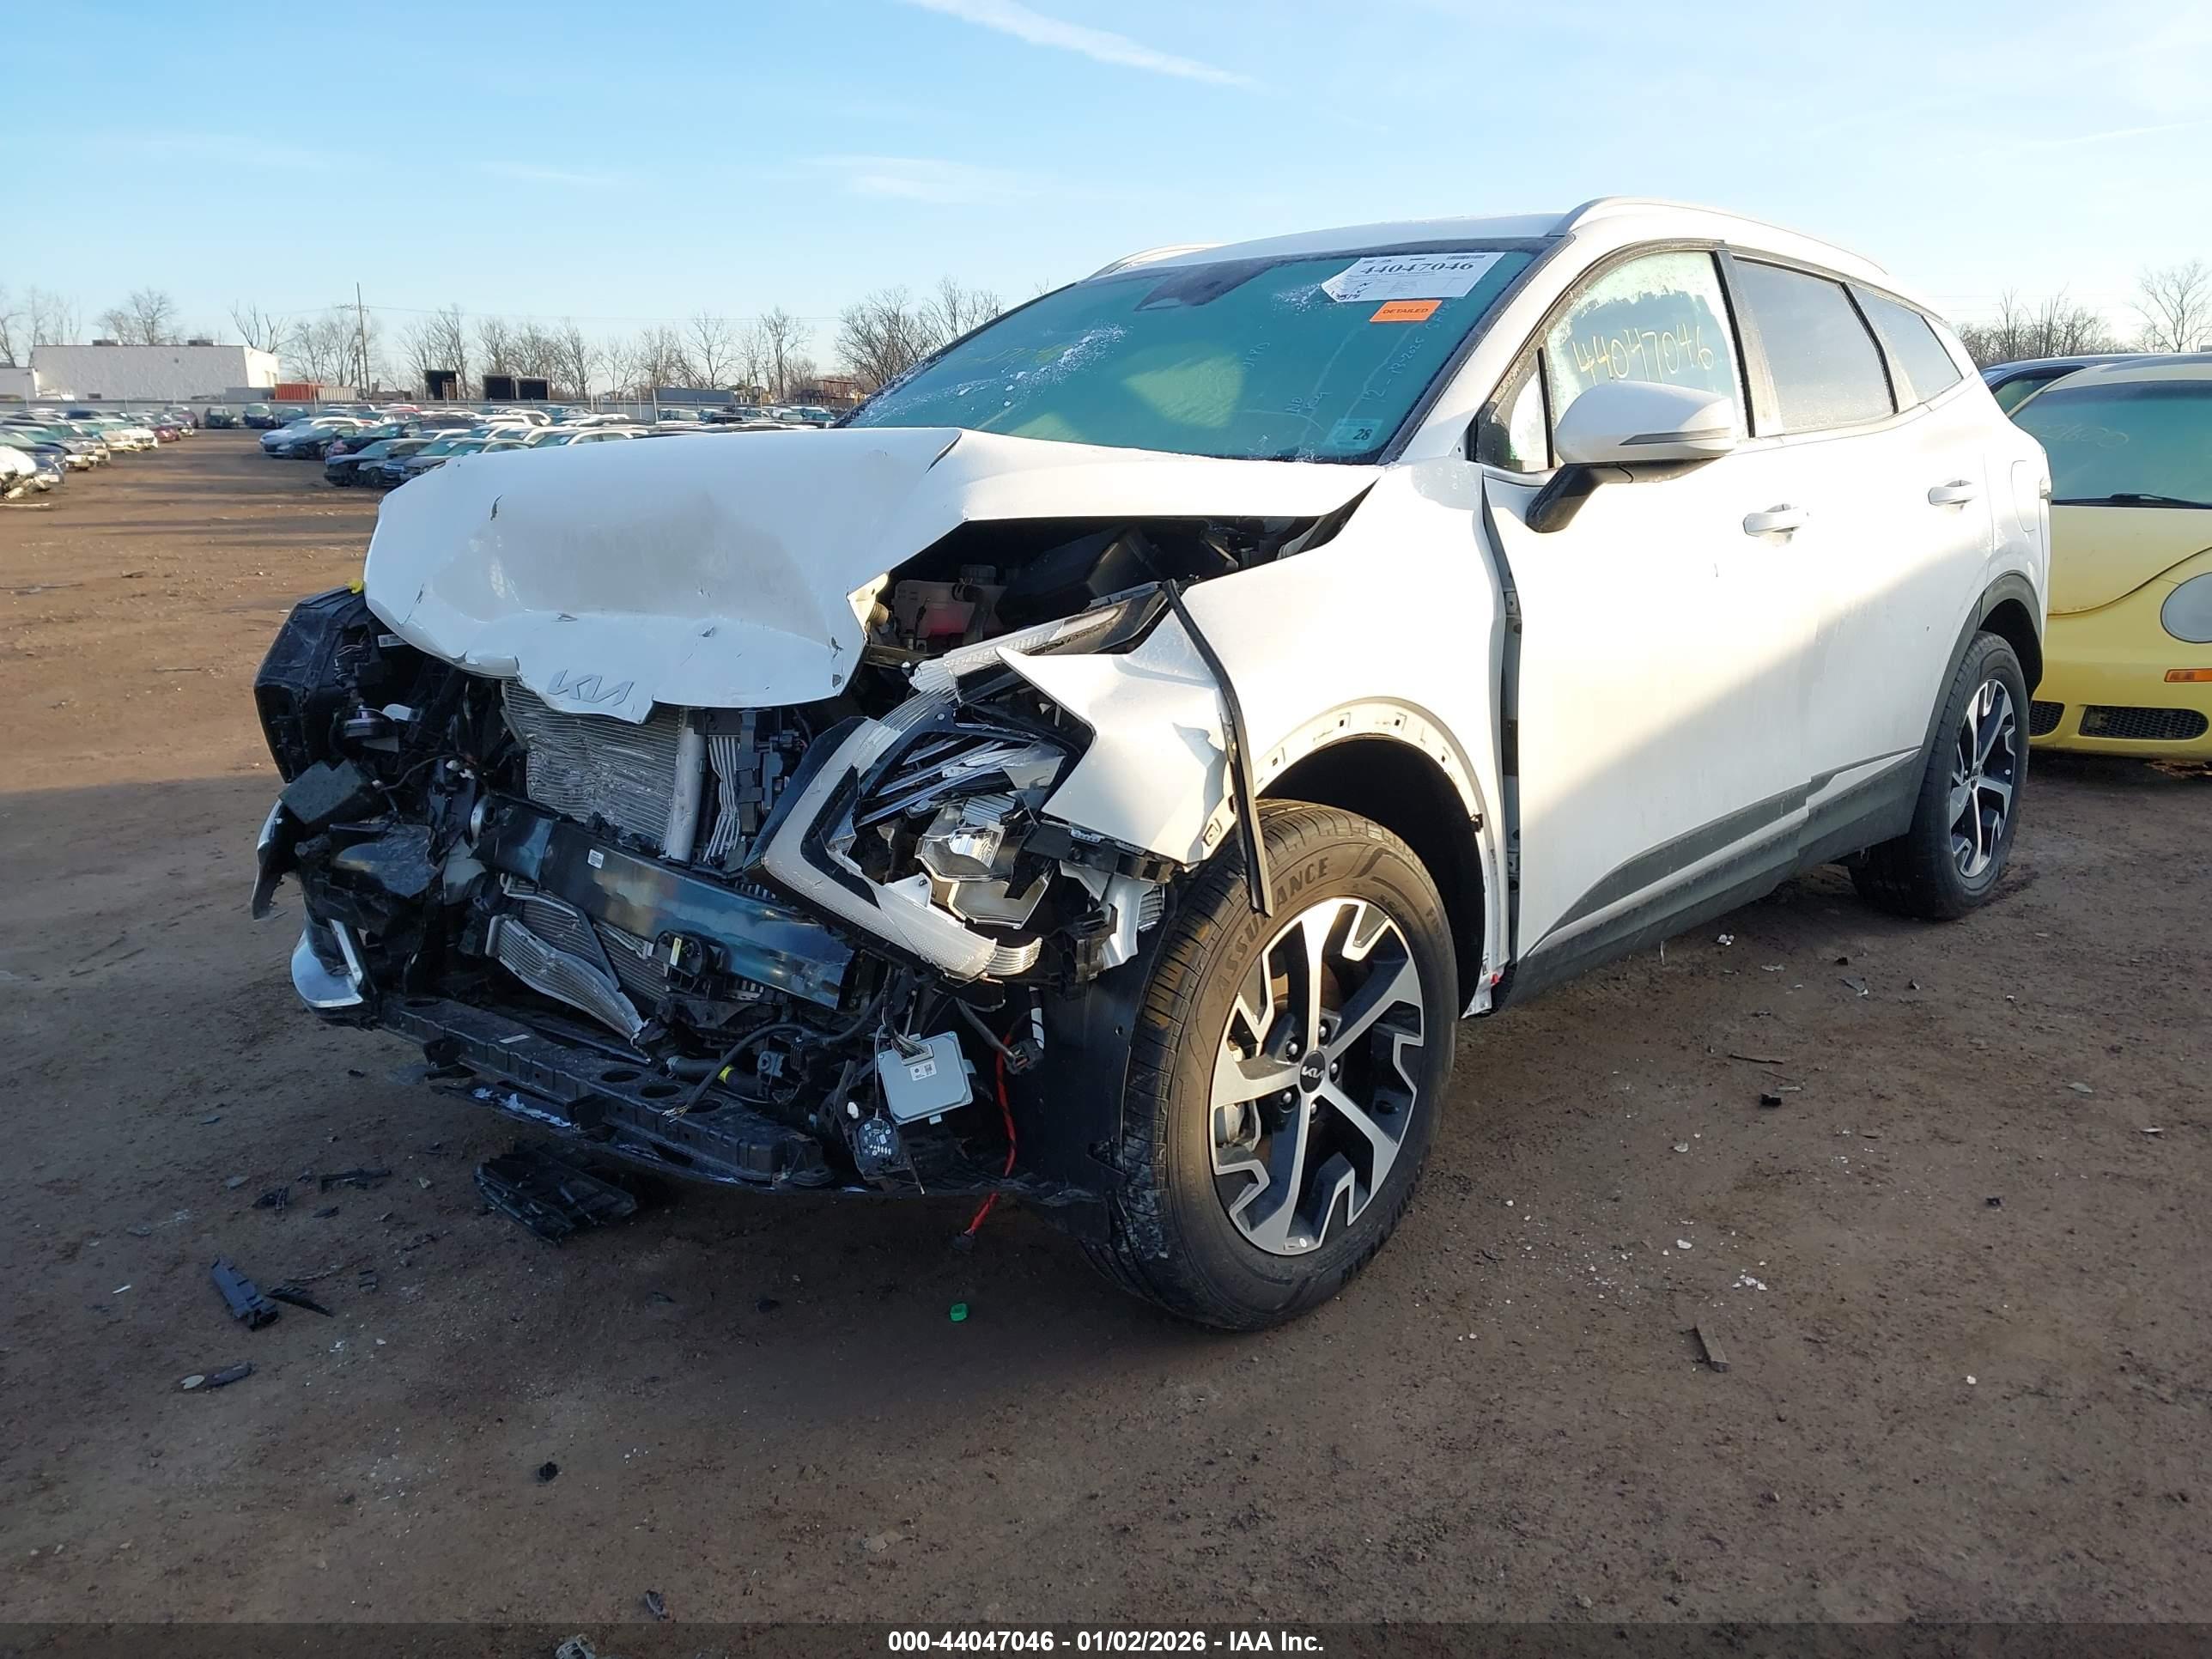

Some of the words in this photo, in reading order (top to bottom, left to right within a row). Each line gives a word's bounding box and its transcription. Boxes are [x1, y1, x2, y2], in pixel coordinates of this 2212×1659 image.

[1359, 261, 1475, 275] 44047046
[1572, 324, 1714, 386] 44047046
[1353, 428, 1373, 441] 28
[546, 668, 635, 708] KIA
[1214, 855, 1330, 998] ASSUANCE
